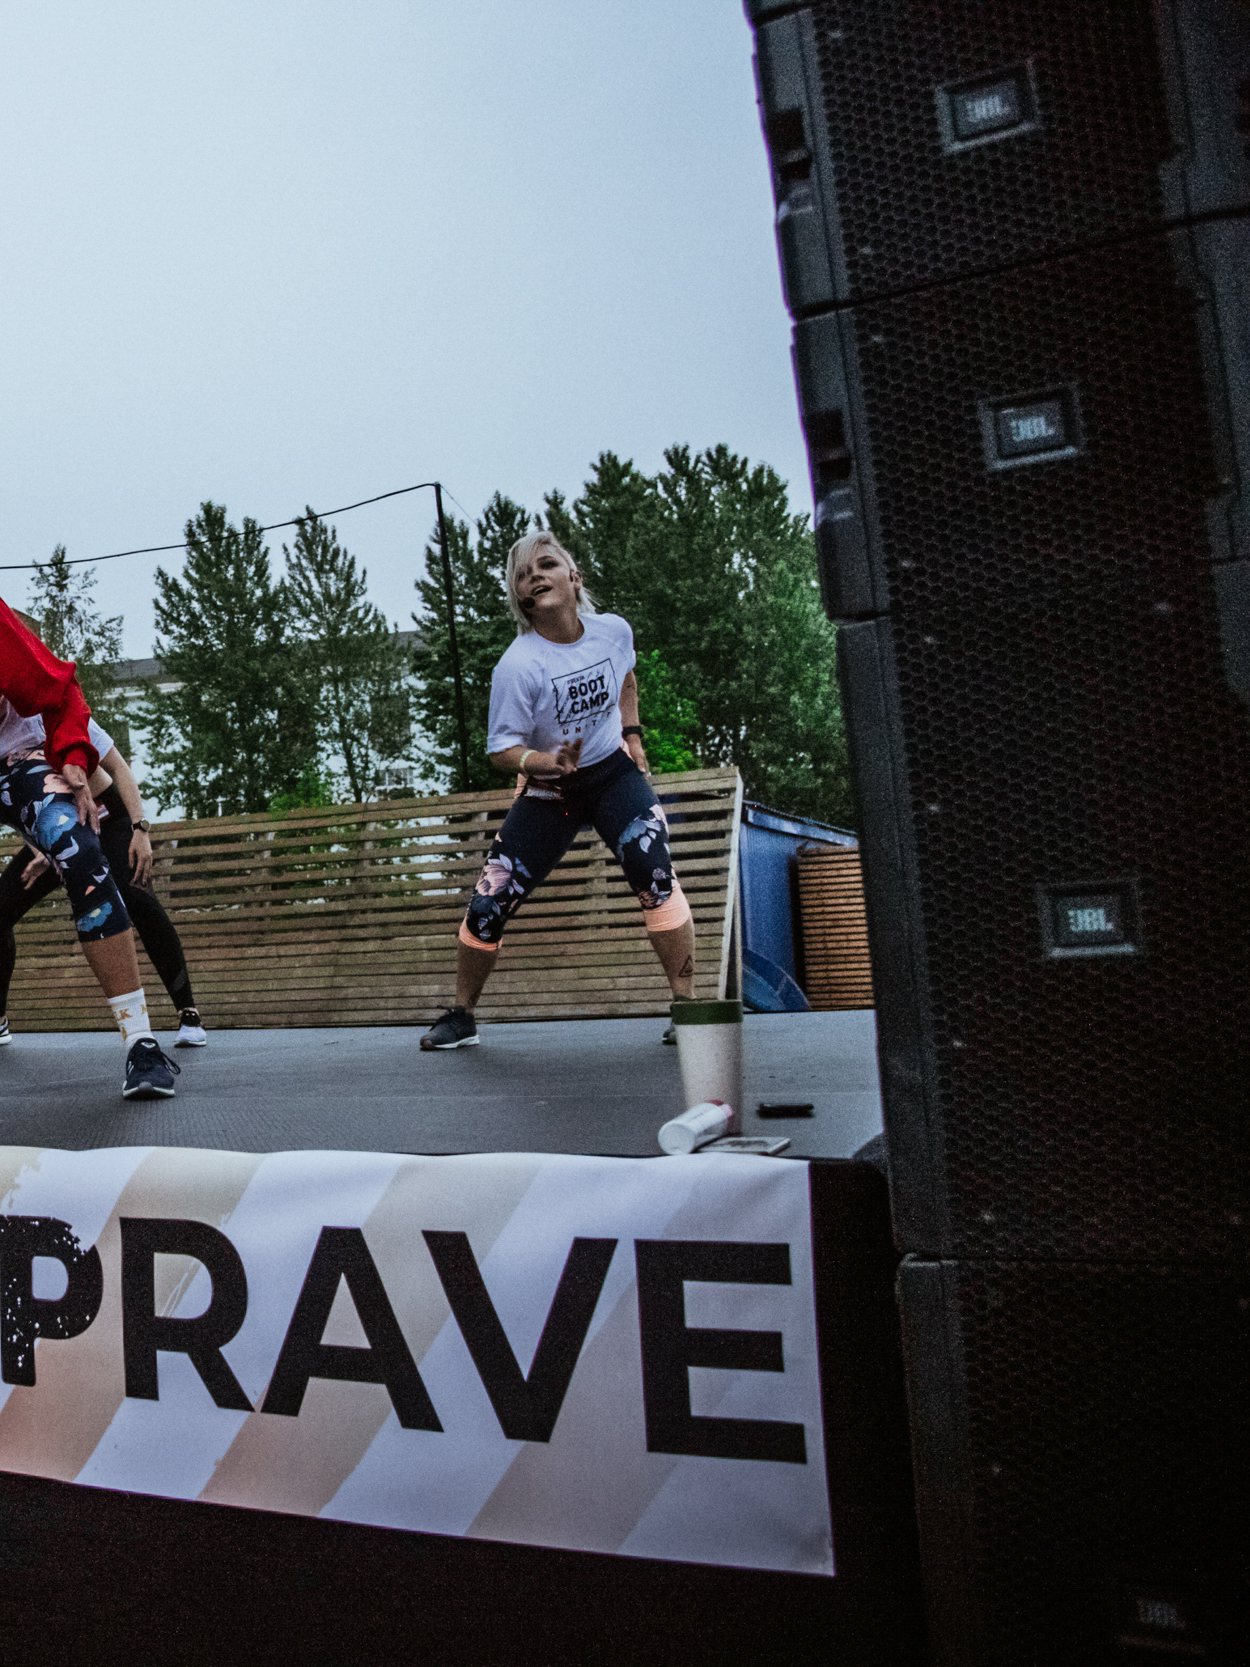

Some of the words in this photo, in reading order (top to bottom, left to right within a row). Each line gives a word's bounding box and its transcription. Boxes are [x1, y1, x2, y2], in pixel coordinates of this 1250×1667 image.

[569, 675, 605, 700] BOOT
[571, 691, 609, 715] CAMP
[1068, 908, 1113, 932] JBL
